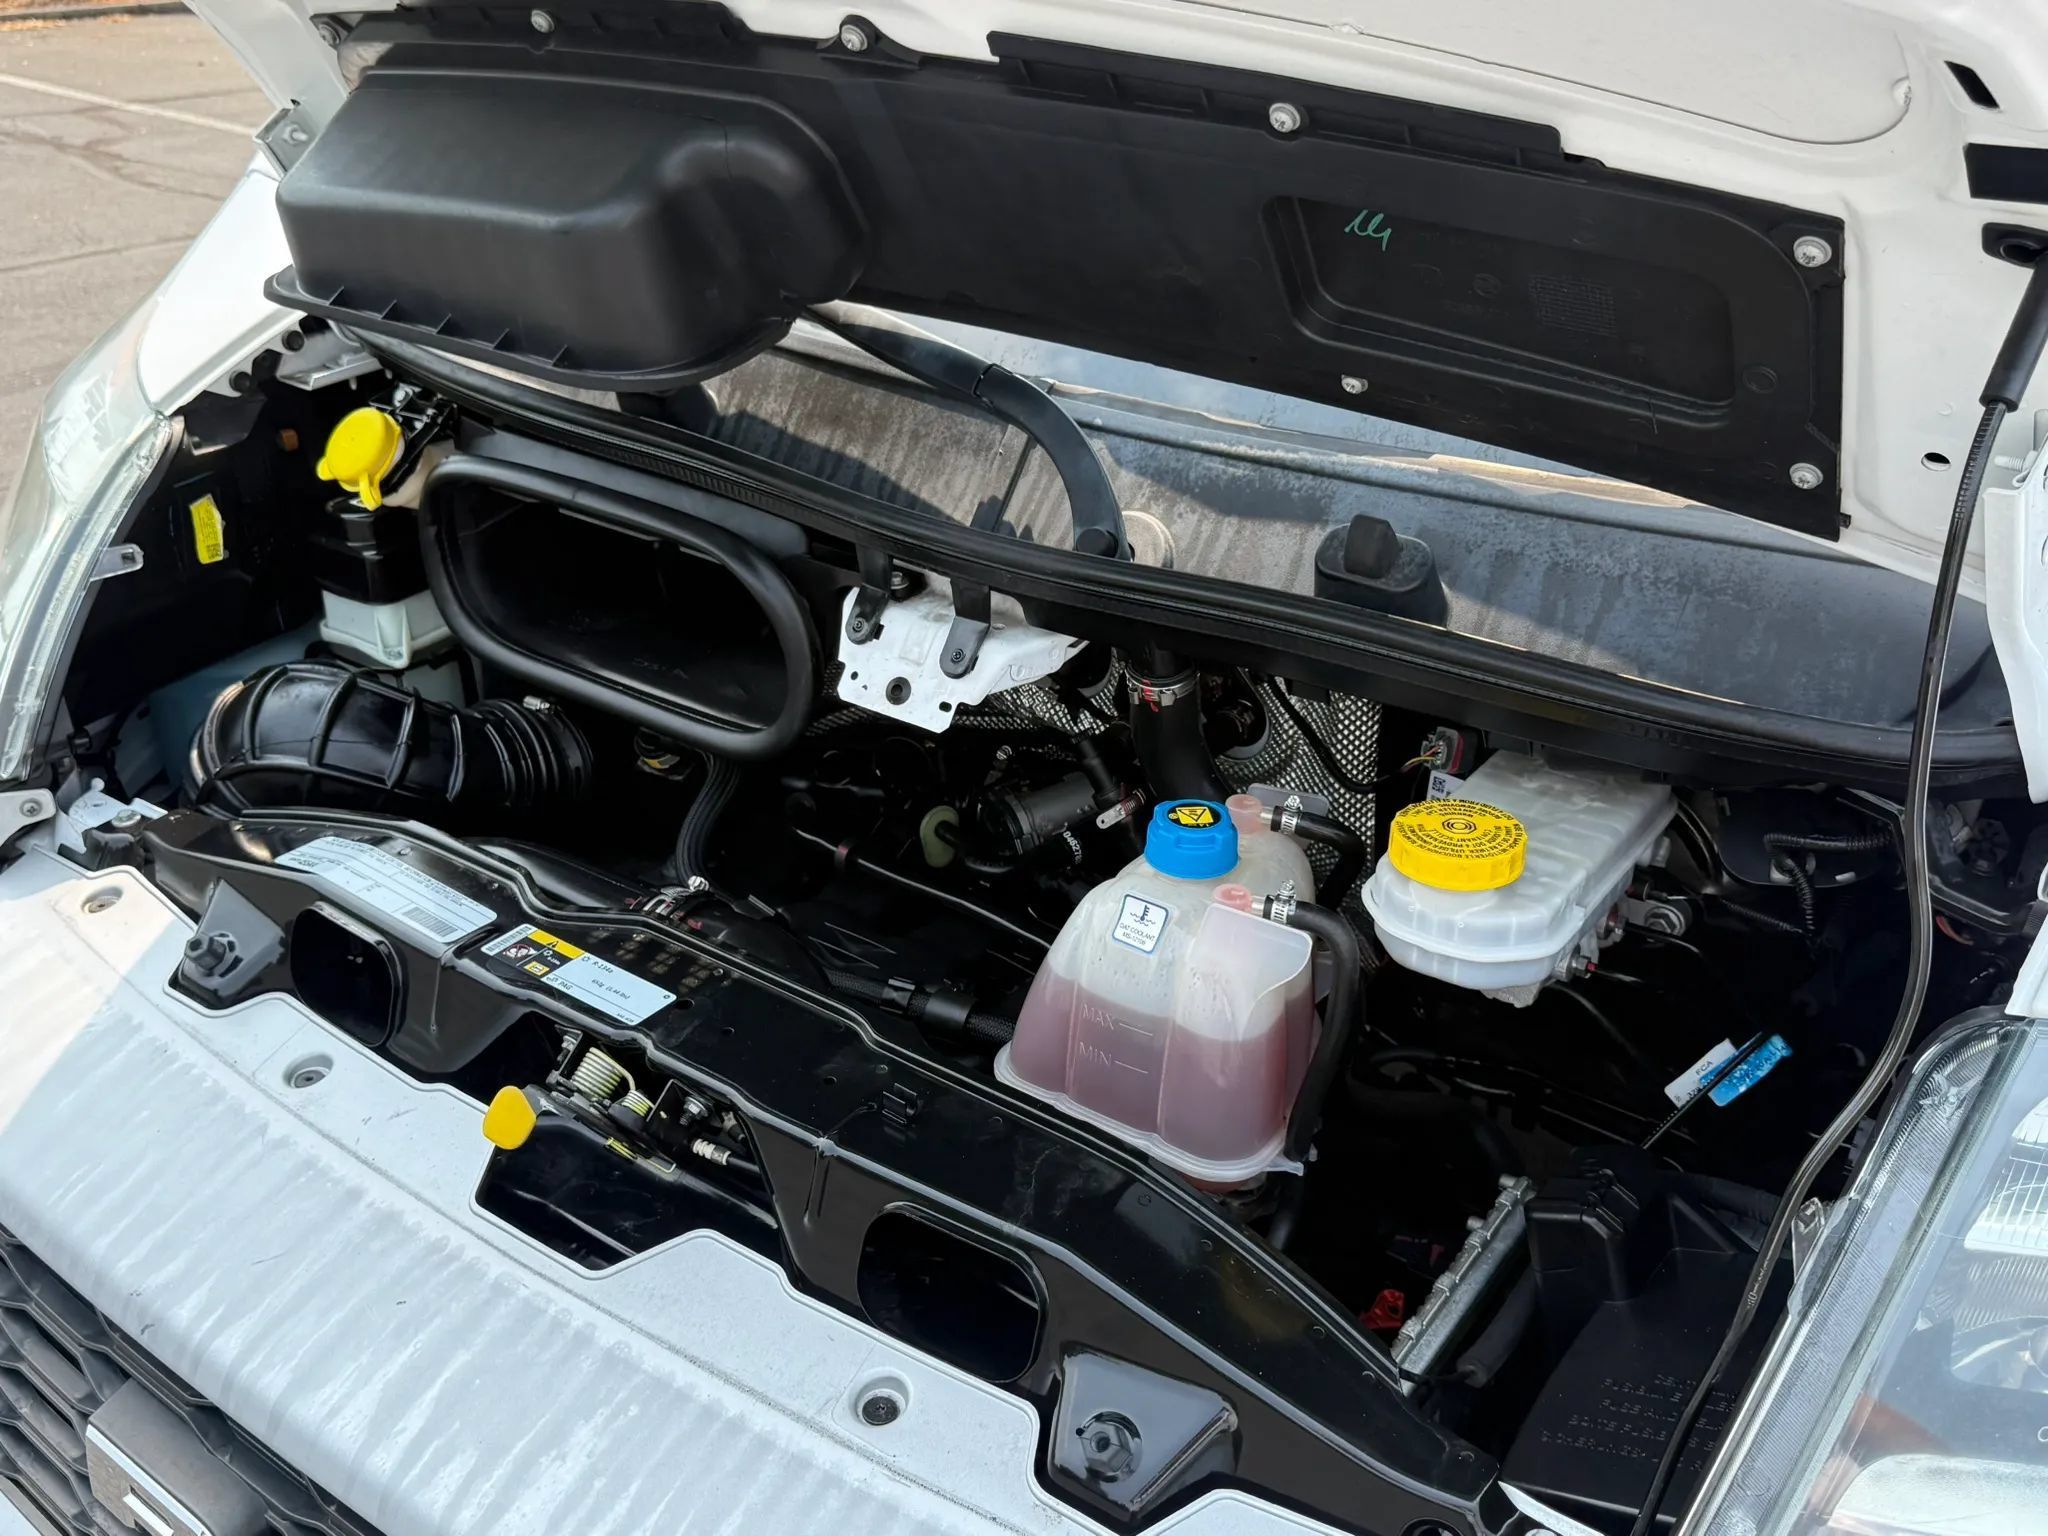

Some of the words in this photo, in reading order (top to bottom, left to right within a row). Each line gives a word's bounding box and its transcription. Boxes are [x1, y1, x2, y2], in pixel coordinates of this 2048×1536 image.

[1130, 927, 1155, 941] COOLANT
[1081, 1001, 1114, 1031] MAX
[1080, 1041, 1112, 1065] MIN
[1695, 1061, 1713, 1075] FCA
